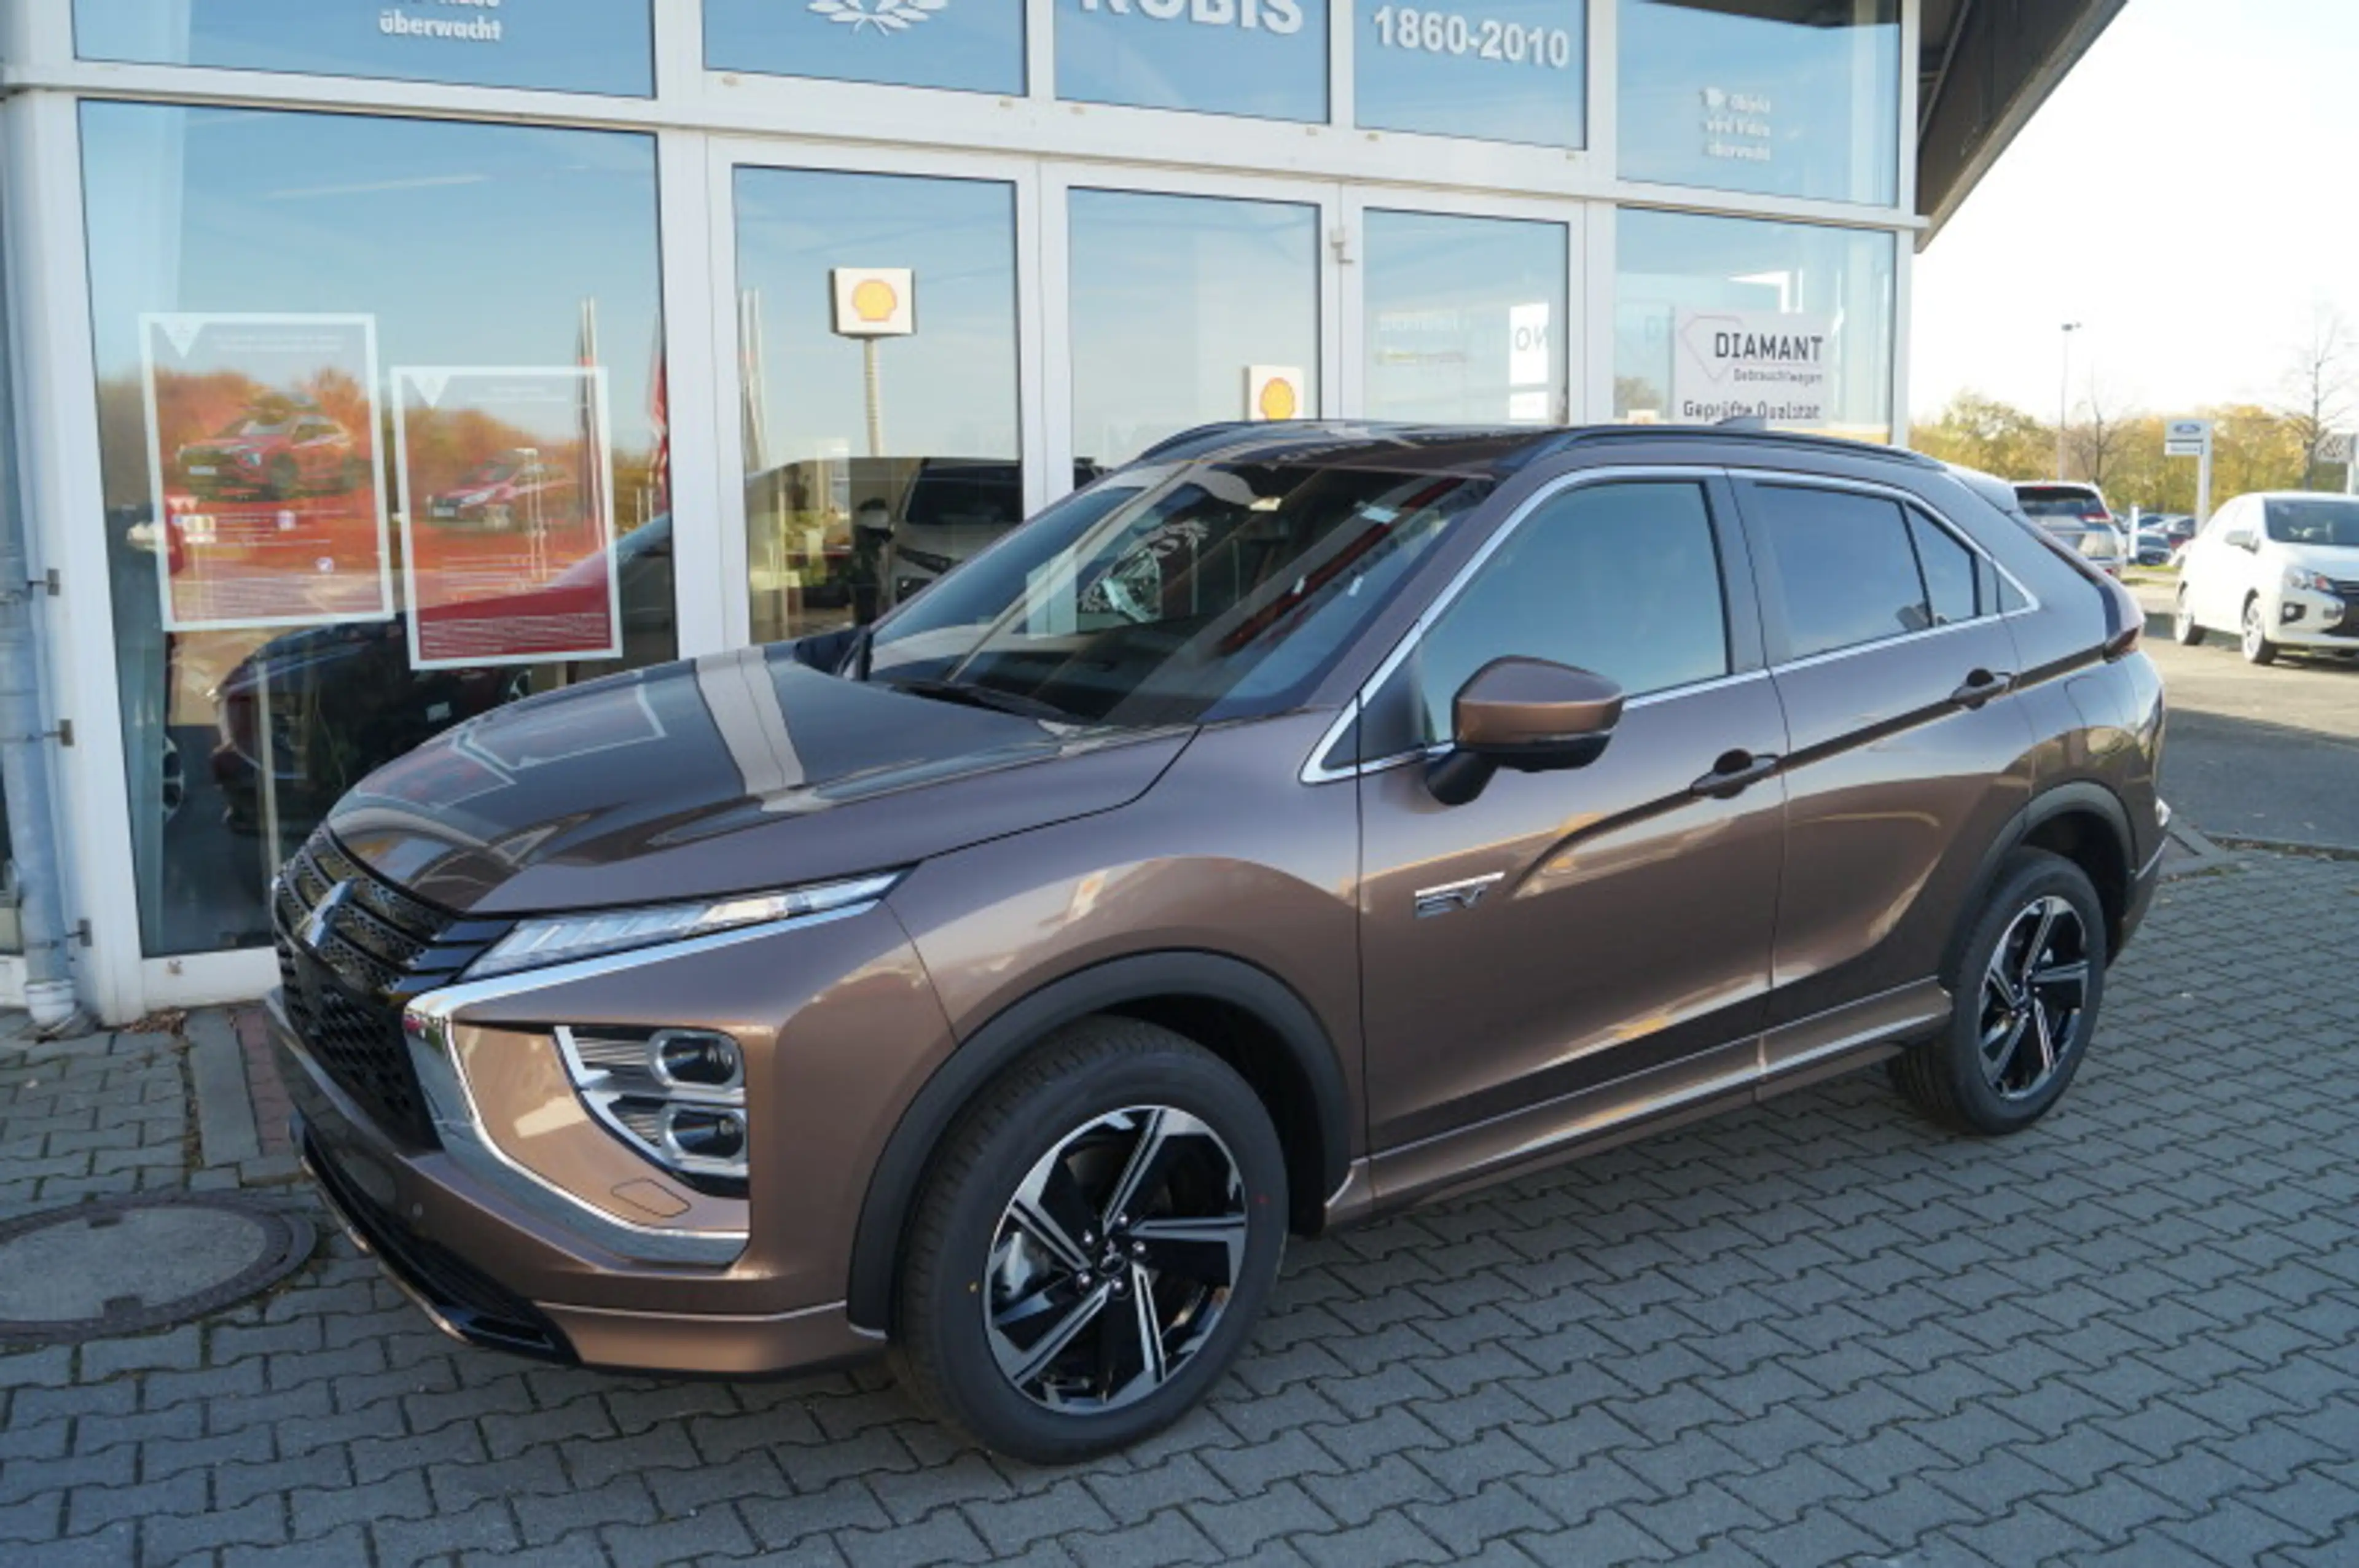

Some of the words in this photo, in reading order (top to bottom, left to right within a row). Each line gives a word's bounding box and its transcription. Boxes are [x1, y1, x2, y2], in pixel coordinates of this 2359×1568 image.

[380, 9, 502, 41] überwacht
[1374, 6, 1570, 68] 1860-2010
[1715, 332, 1824, 361] DIAMANT
